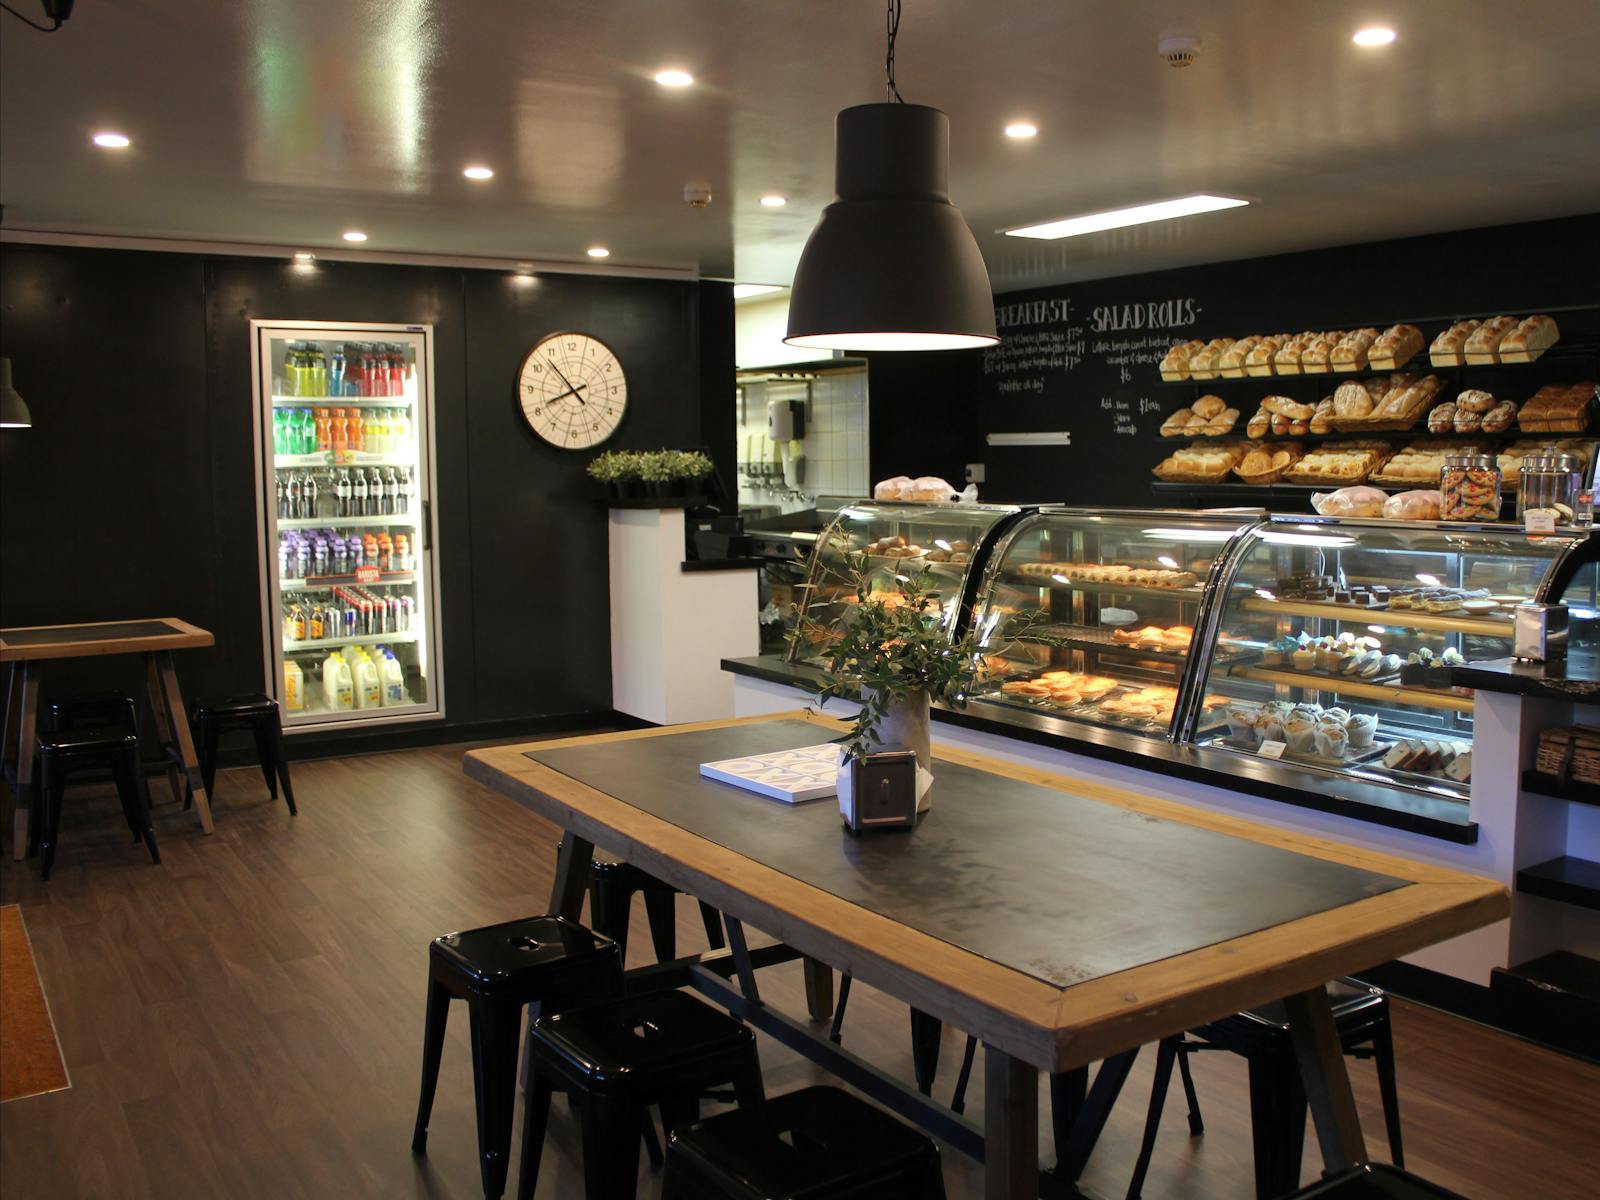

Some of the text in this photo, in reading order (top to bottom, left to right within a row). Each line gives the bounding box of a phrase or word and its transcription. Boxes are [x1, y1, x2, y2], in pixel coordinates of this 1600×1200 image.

[567, 342, 577, 352] 12
[548, 348, 555, 357] 11
[533, 364, 542, 373] 10
[605, 363, 612, 372] 2
[1120, 366, 1132, 384] $6
[527, 385, 534, 394] 9
[611, 386, 618, 394] 3
[535, 407, 541, 416] 8
[607, 407, 613, 416] 4
[550, 423, 556, 432] 7
[592, 423, 599, 432] 5
[571, 430, 577, 439] 6
